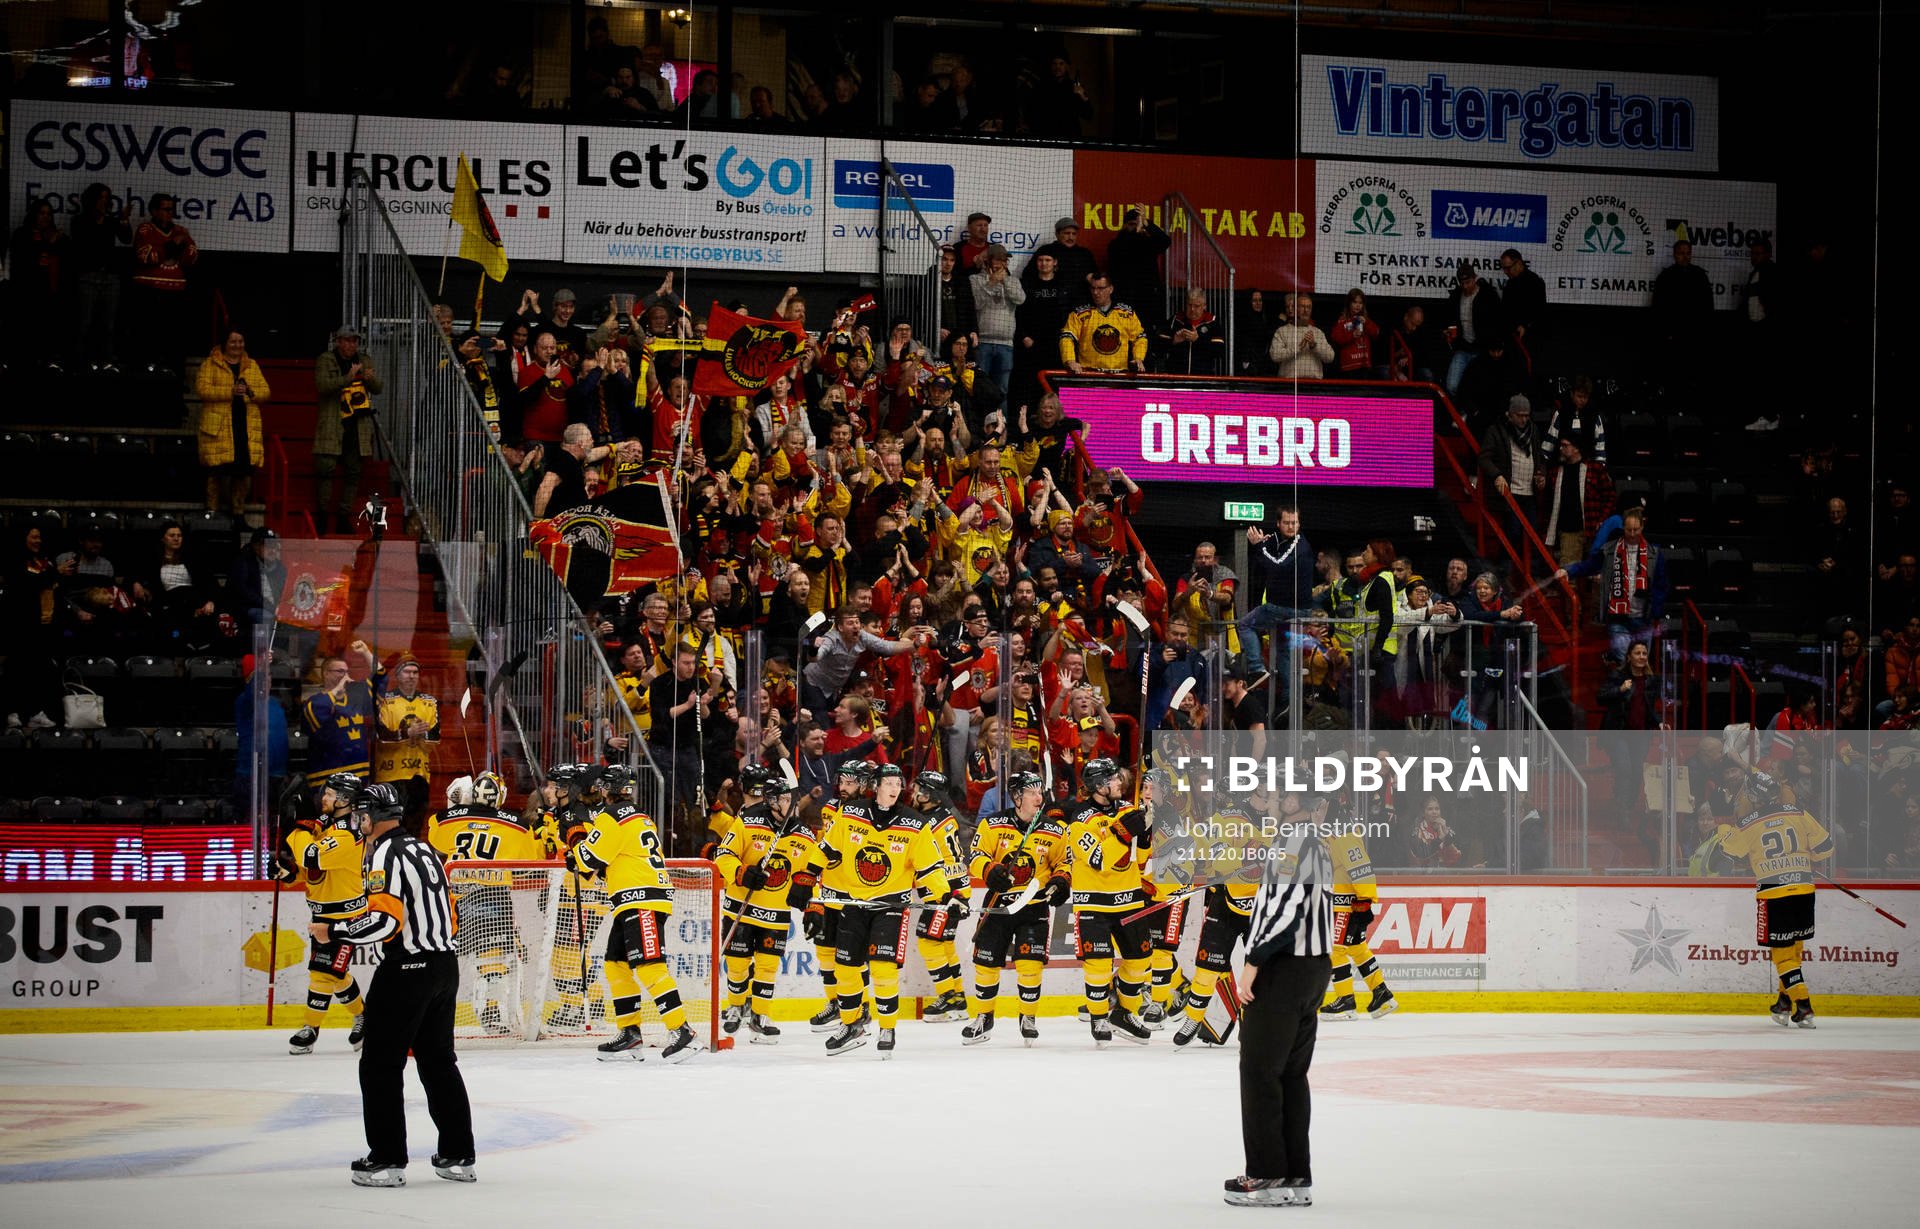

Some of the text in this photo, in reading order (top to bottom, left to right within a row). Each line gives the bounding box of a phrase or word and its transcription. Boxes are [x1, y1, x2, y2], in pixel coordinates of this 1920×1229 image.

[1327, 65, 1694, 158] Vintergatan
[25, 121, 267, 178] ESSWEGE
[228, 193, 275, 222] AB
[716, 200, 813, 216] By Bus Örebro
[1320, 176, 1426, 238] ÖREBRO FOGFRIA GOLV AB
[1200, 208, 1259, 237] TAK
[1267, 212, 1307, 238] AB
[1472, 206, 1532, 229] MAPEI
[1554, 195, 1655, 256] ÖREBRO FOGFRIA GOLV AB
[584, 221, 807, 243] När du behöver busstransport!
[833, 225, 845, 238] a
[935, 225, 954, 241] of
[960, 227, 1040, 249] eergy
[1688, 222, 1772, 248] weber
[1334, 252, 1363, 264] ETT
[1369, 253, 1429, 268] STARKT
[1360, 271, 1391, 286] FÖR
[1397, 274, 1458, 288] STARKA
[1558, 277, 1586, 290] ETT
[1141, 403, 1351, 468] ÖREBRO
[447, 808, 518, 822] SSAB SSAB
[844, 805, 922, 828] SSAB SSAB
[989, 817, 1063, 834] SSAB SSAB
[452, 832, 500, 860] 34
[1078, 832, 1096, 851] 32
[1761, 827, 1798, 859] 21
[1348, 847, 1363, 863] 23
[1779, 873, 1801, 884] SSAB
[621, 890, 646, 902] SSAB
[1114, 893, 1134, 905] SSAB
[750, 909, 777, 921] SSAB
[1688, 944, 1899, 967] Zinkgrun Mining
[401, 962, 428, 970] CCM
[1383, 967, 1462, 977] MAINTENANCE
[1465, 967, 1480, 977] AB
[12, 980, 100, 997] GROUP
